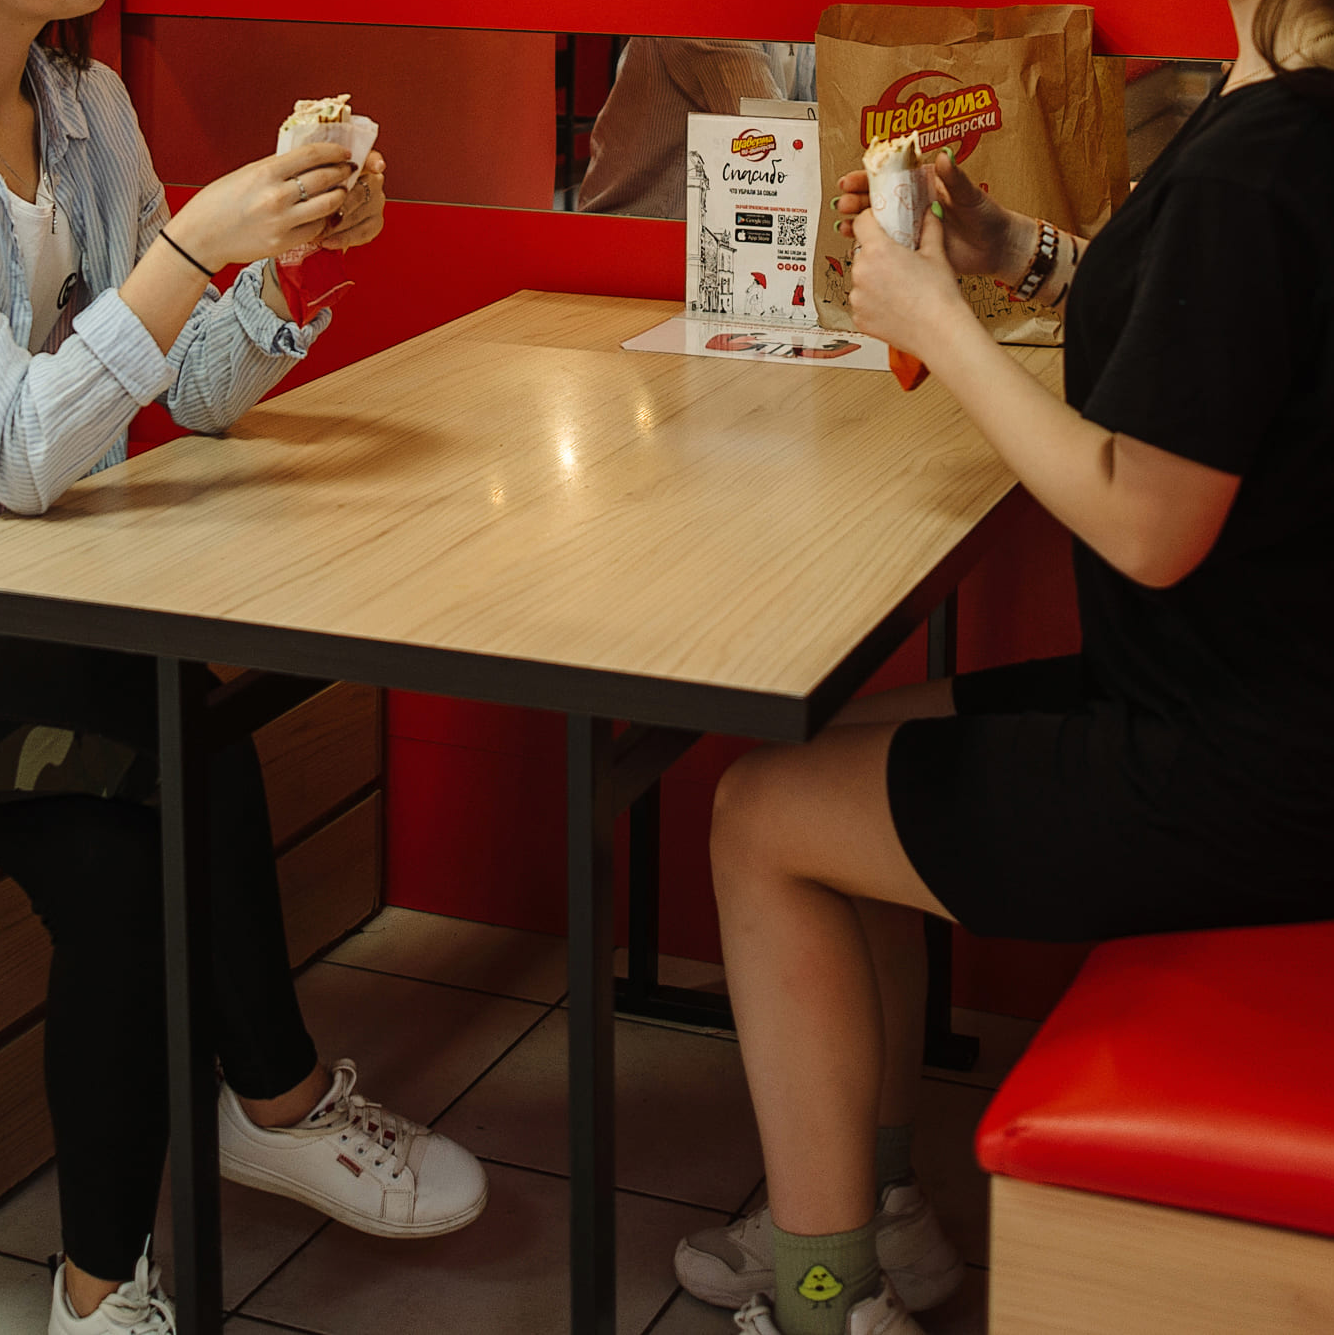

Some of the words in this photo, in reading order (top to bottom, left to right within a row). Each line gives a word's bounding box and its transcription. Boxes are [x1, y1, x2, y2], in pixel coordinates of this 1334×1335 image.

[866, 89, 992, 144] Шаверма
[919, 111, 996, 148] питерски
[732, 135, 774, 152] Шаверма
[722, 158, 788, 185] Спасибо
